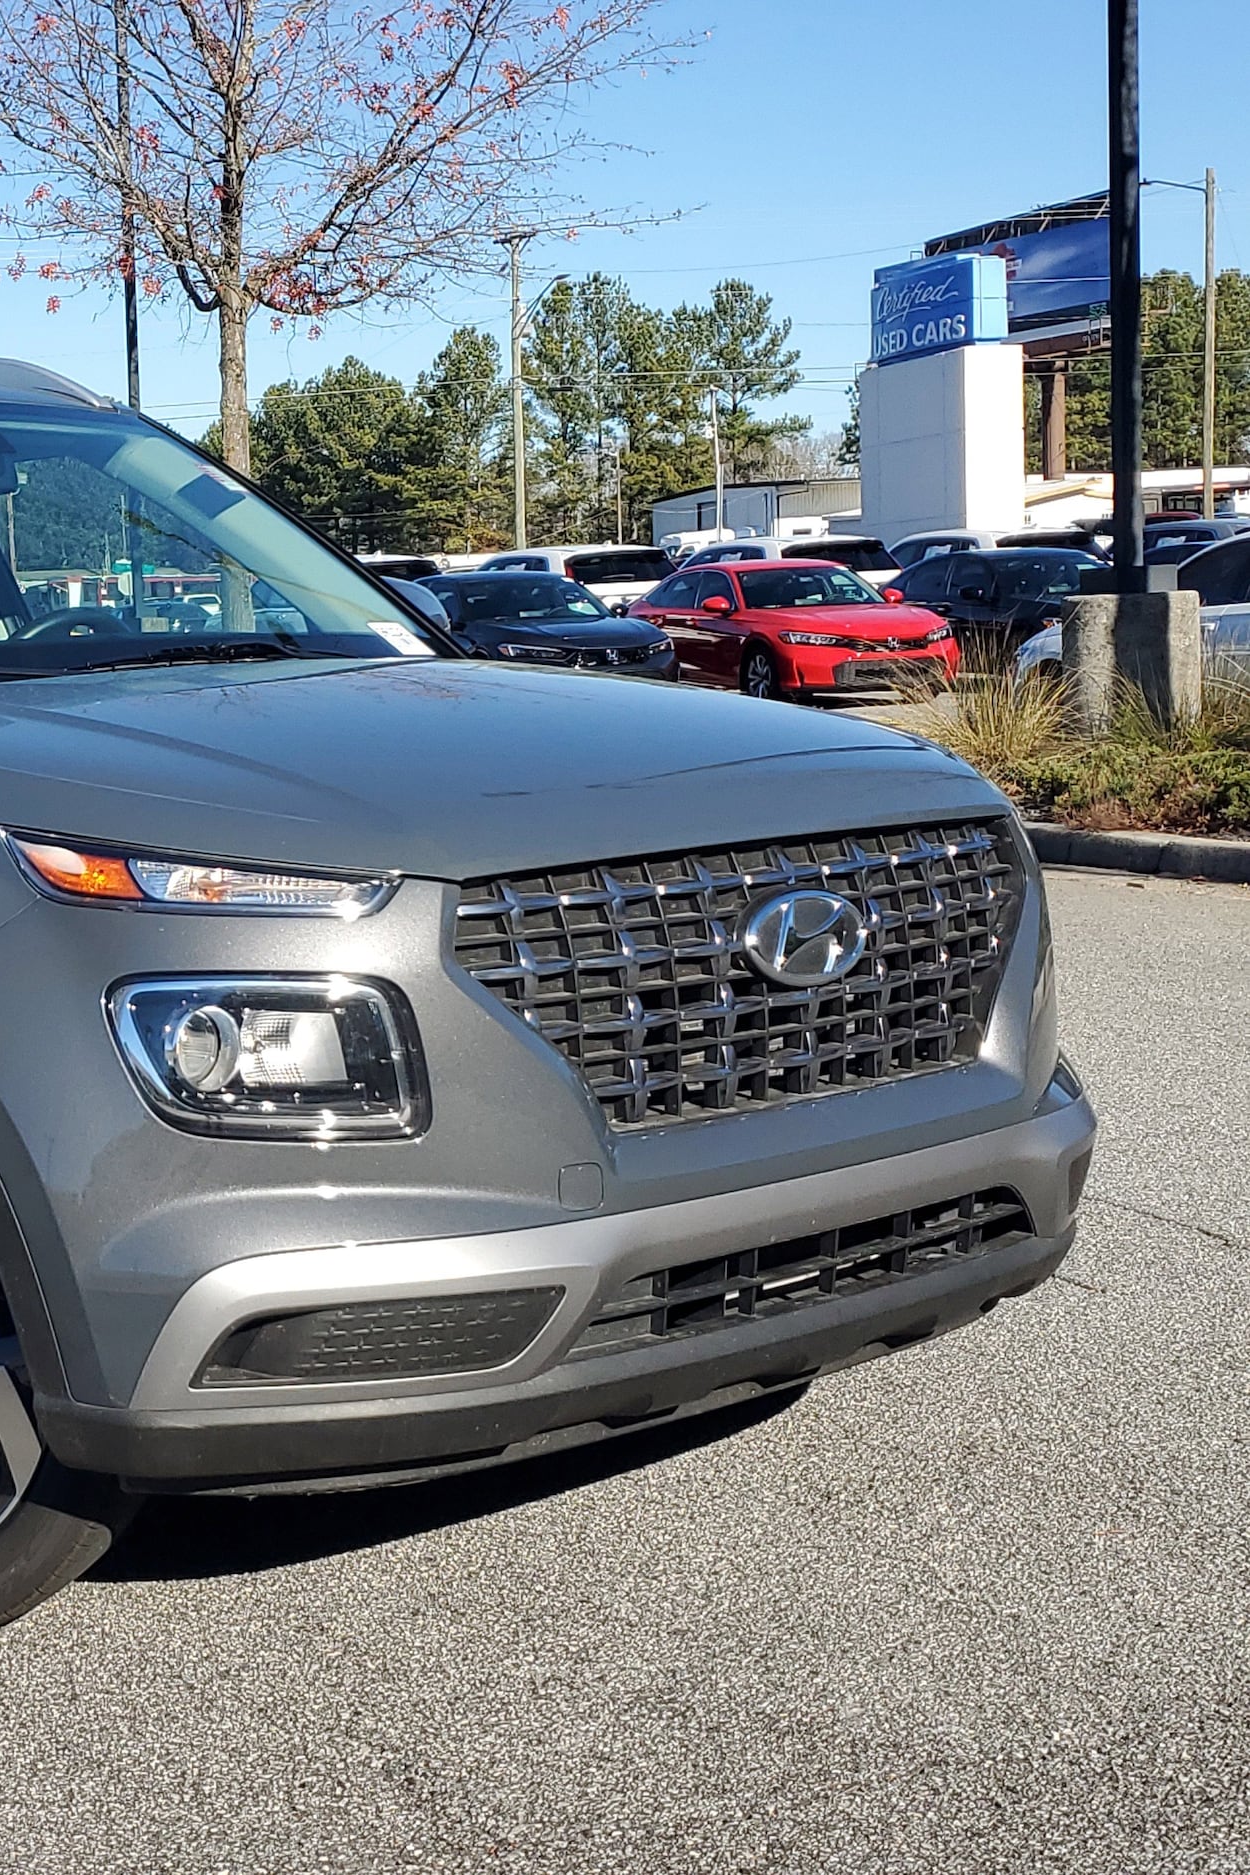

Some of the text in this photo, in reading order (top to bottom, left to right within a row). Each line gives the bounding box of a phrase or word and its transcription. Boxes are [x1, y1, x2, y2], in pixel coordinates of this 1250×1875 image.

[877, 275, 959, 323] Certified
[873, 314, 966, 357] USED CARS
